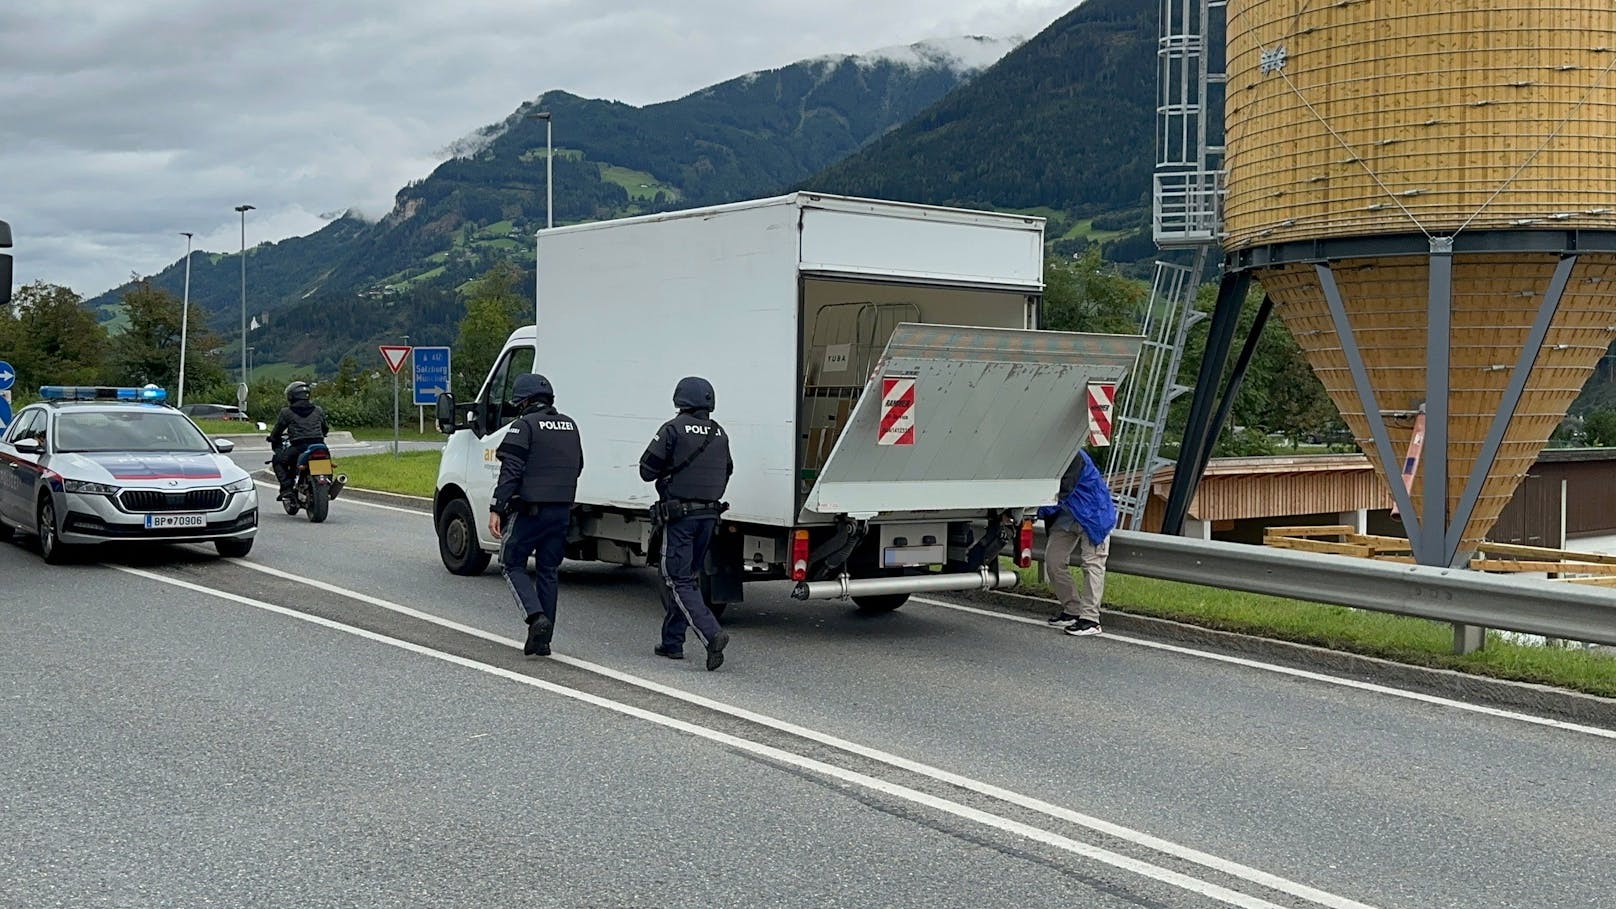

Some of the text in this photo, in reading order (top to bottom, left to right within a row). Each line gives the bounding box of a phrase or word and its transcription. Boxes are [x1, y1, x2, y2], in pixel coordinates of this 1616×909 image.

[416, 365, 447, 375] Salzburg
[539, 421, 574, 431] POLIZEI
[154, 517, 166, 526] BP
[173, 516, 202, 526] 70906
